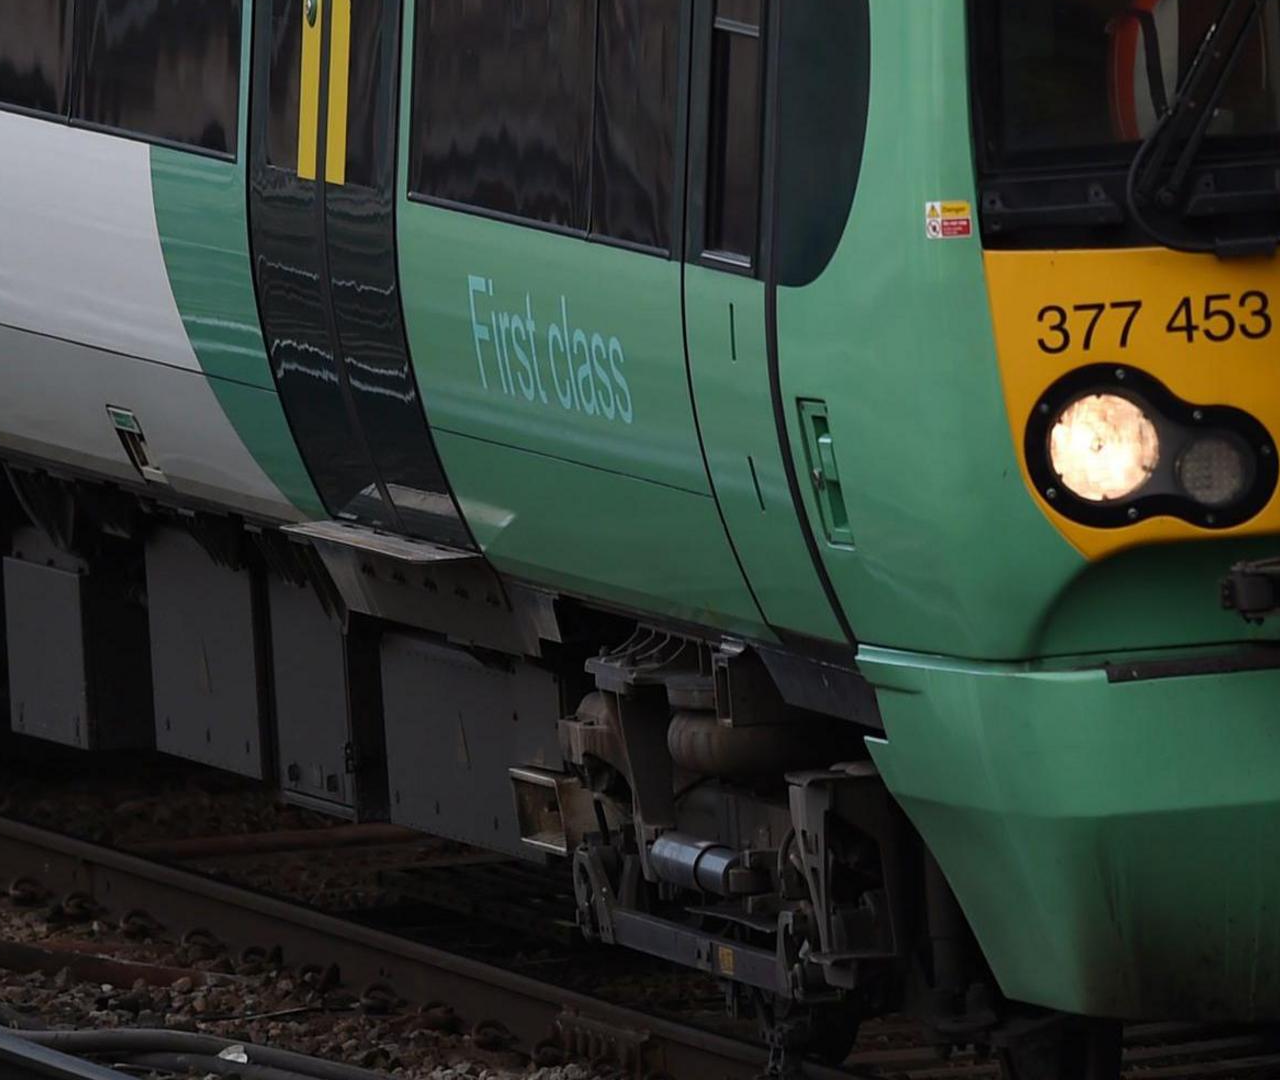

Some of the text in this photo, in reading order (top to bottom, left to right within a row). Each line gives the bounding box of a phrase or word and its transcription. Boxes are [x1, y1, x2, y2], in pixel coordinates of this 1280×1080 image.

[468, 274, 632, 424] First class
[1037, 290, 1272, 354] 377 453
